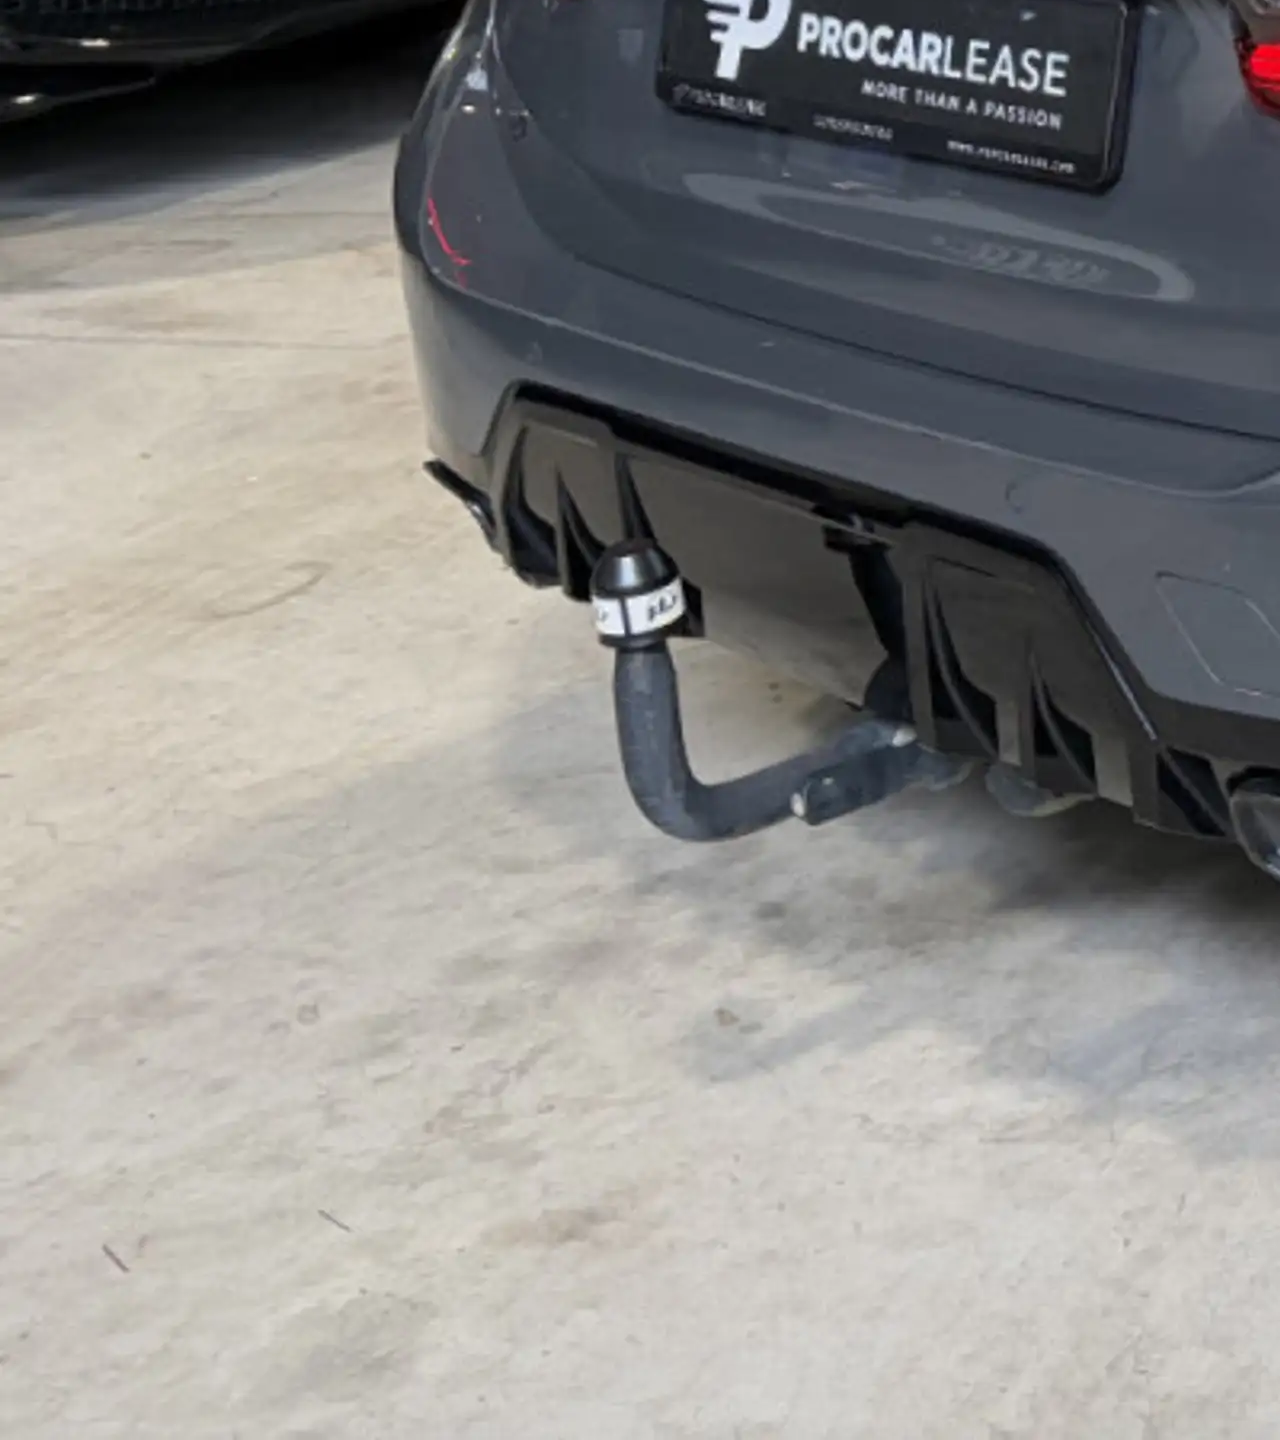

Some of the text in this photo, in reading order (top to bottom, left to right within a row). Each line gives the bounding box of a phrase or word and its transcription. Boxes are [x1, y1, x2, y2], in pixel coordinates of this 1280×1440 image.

[796, 12, 1071, 98] PROCARLEASE
[861, 79, 1064, 131] MORE THAN A PASSION
